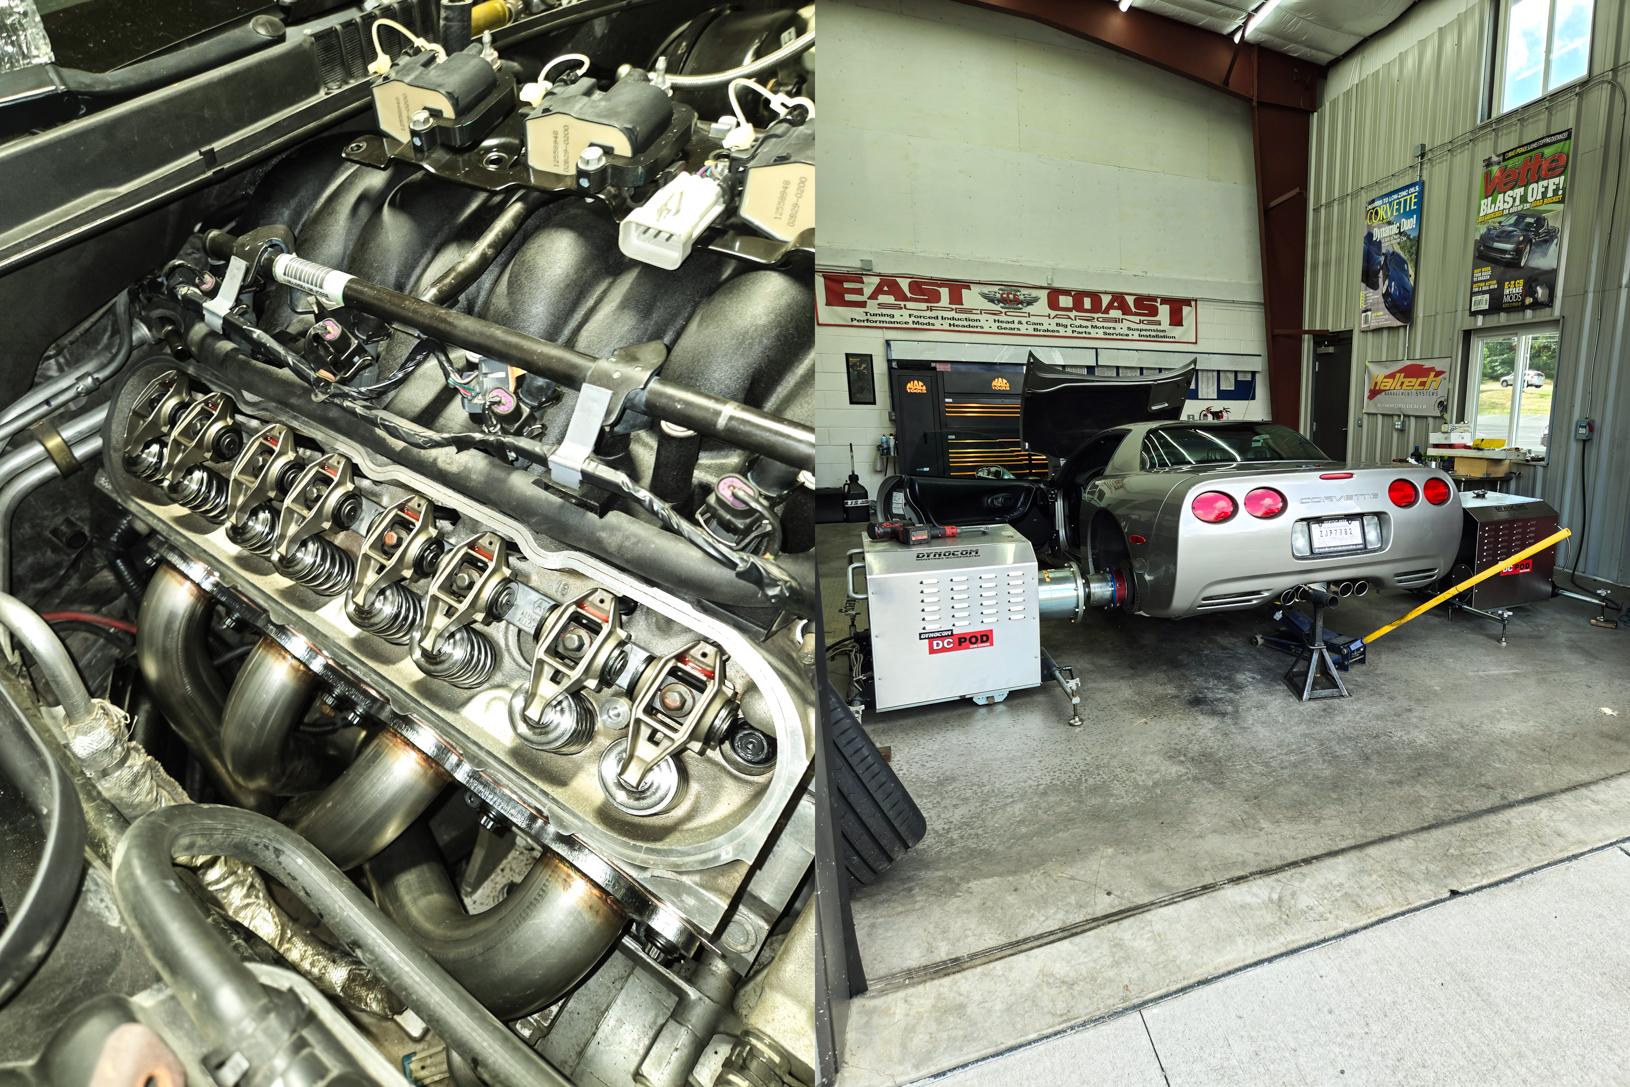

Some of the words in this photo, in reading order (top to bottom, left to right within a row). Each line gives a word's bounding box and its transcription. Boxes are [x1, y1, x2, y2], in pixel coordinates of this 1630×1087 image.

[1484, 153, 1567, 198] Vette
[1480, 187, 1524, 216] BLAST
[1527, 176, 1564, 202] OFF!
[1367, 192, 1418, 224] CORVETTE
[822, 274, 971, 308] EAST
[1047, 290, 1192, 326] COAST
[1503, 294, 1522, 303] MODS
[863, 311, 895, 319] Tuning
[908, 313, 939, 321] Forced
[941, 315, 981, 323] Induction
[1126, 326, 1167, 334] Suspension
[877, 302, 1161, 326] SUPERCHARGING
[850, 317, 909, 326] Performance
[1138, 332, 1176, 340] Installation
[1371, 371, 1442, 391] Haltech
[1300, 493, 1379, 504] CORVETTE
[916, 549, 979, 558] DYNOCOM
[921, 631, 952, 639] DYNOCOM
[933, 638, 954, 650] DC
[958, 634, 990, 646] POD
